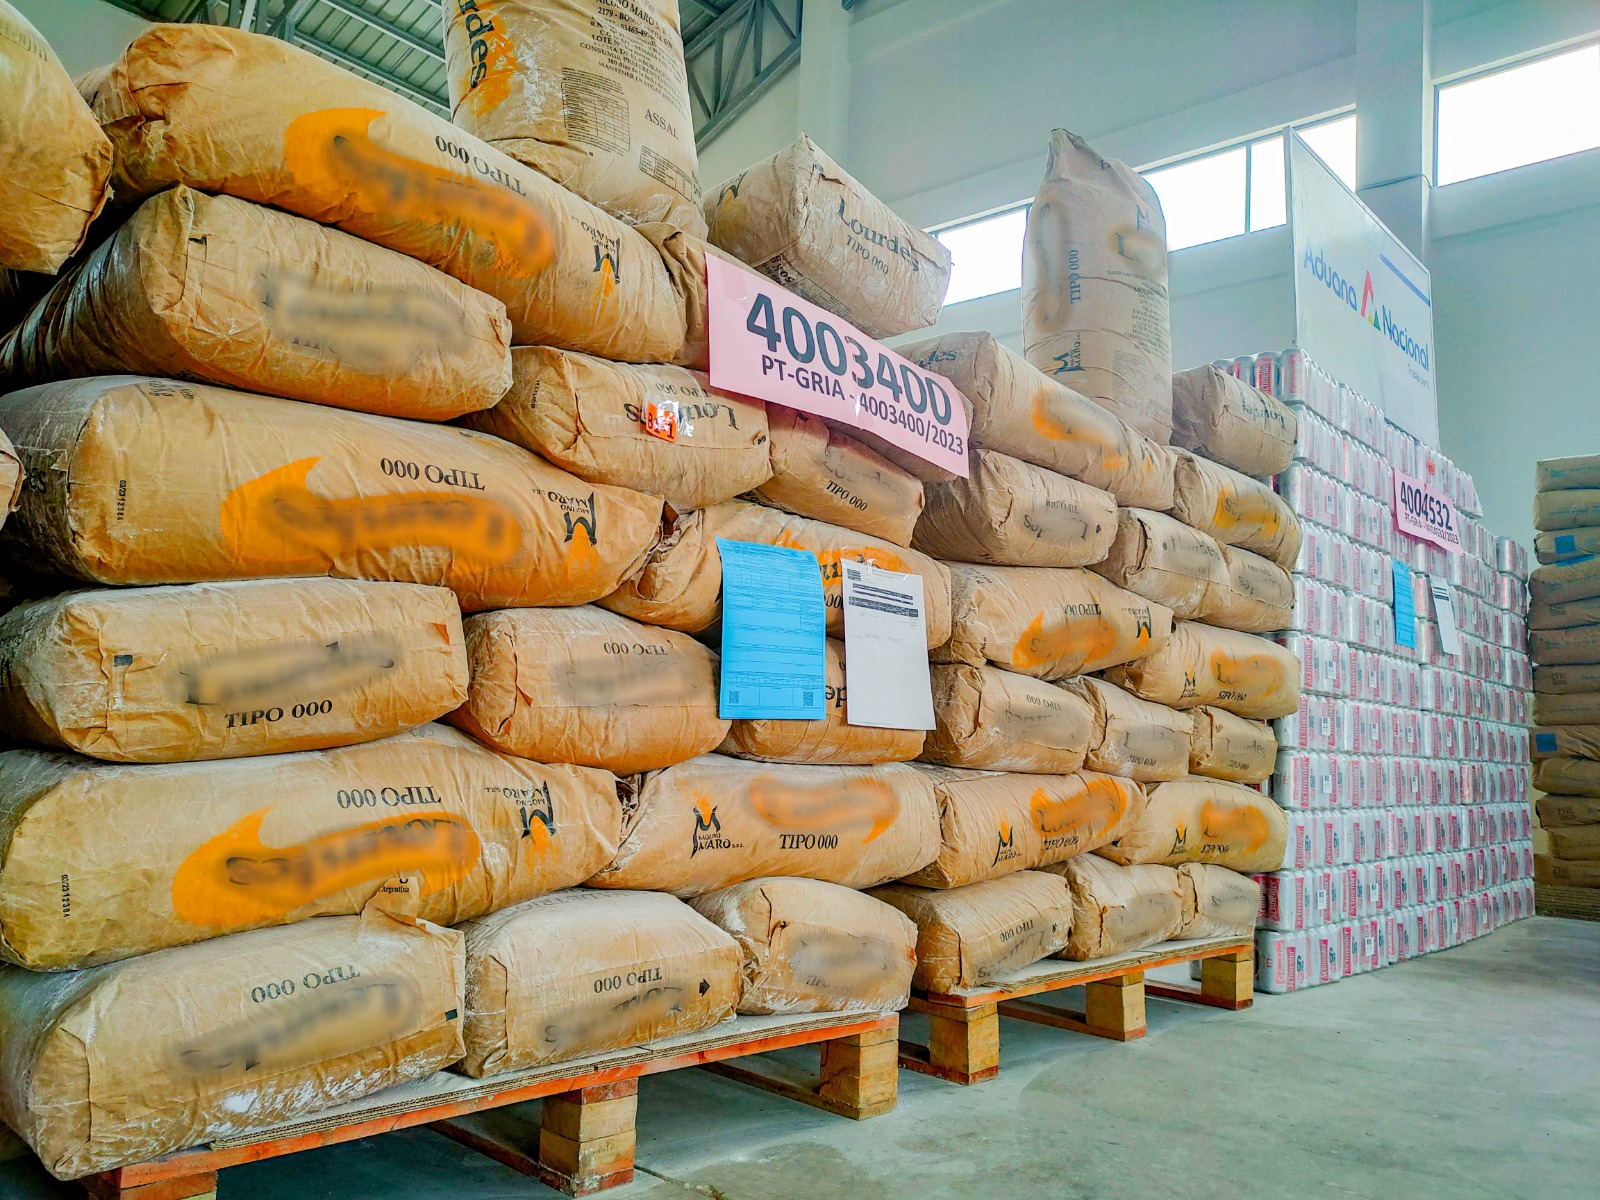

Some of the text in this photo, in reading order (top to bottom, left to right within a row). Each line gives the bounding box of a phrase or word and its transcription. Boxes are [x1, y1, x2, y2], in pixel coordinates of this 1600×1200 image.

[645, 109, 679, 140] ASSAL
[435, 135, 526, 197] TIPO 000
[838, 197, 920, 272] Lourdes
[846, 234, 889, 275] TIPO 000
[1068, 249, 1082, 304] 000 TIPO
[1304, 247, 1358, 312] Aduana
[1382, 304, 1430, 372] Nacional
[747, 293, 951, 426] 4003400
[762, 354, 964, 456] PT-GRIA 4003400/2023
[380, 457, 486, 491] TIPO 000
[826, 479, 868, 512] TIPO 000
[1400, 481, 1453, 531] 4004532
[1078, 603, 1102, 616] TIPO
[603, 642, 668, 656] TIPO 000
[224, 699, 333, 729] TIPO 000
[337, 786, 442, 809] TIPO 000
[779, 833, 838, 850] TIPO 000
[381, 885, 410, 894] Argentina
[251, 964, 360, 1004] TIPO 000
[594, 966, 663, 994] TIPO 000
